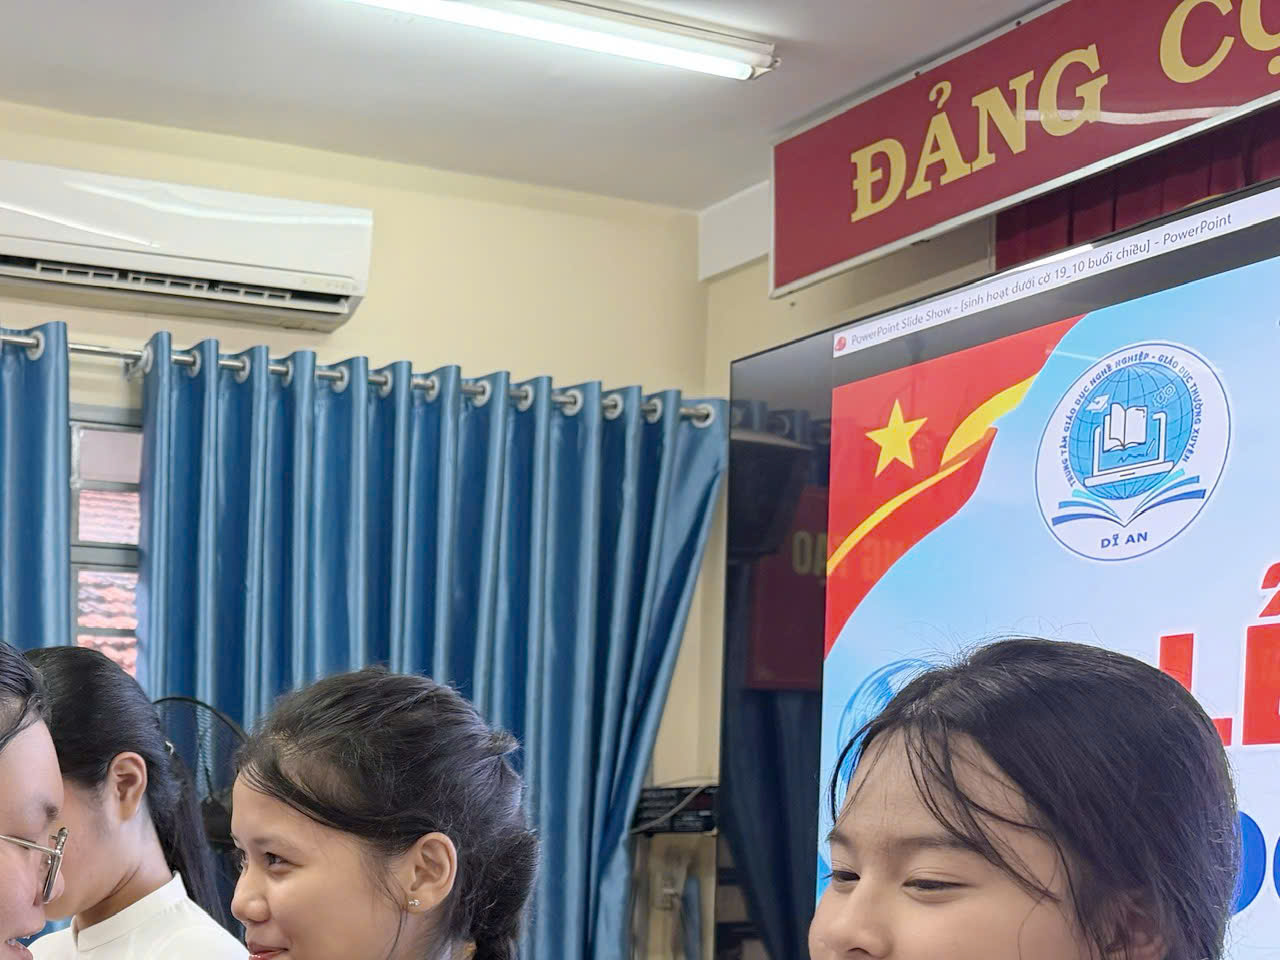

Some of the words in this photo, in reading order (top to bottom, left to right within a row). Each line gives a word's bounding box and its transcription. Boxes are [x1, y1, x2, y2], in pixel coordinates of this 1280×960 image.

[850, 44, 1109, 223] ĐẢNG
[851, 321, 900, 345] PowerPoint
[901, 313, 924, 329] Slide
[925, 307, 952, 322] Show
[986, 288, 1010, 303] hoạt
[1011, 276, 1036, 294] dưới
[1038, 272, 1051, 286] cờ
[1055, 260, 1085, 279] 19_10
[1088, 251, 1113, 269] buổi
[1163, 213, 1232, 246] PowerPoint
[1125, 531, 1148, 545] AN
